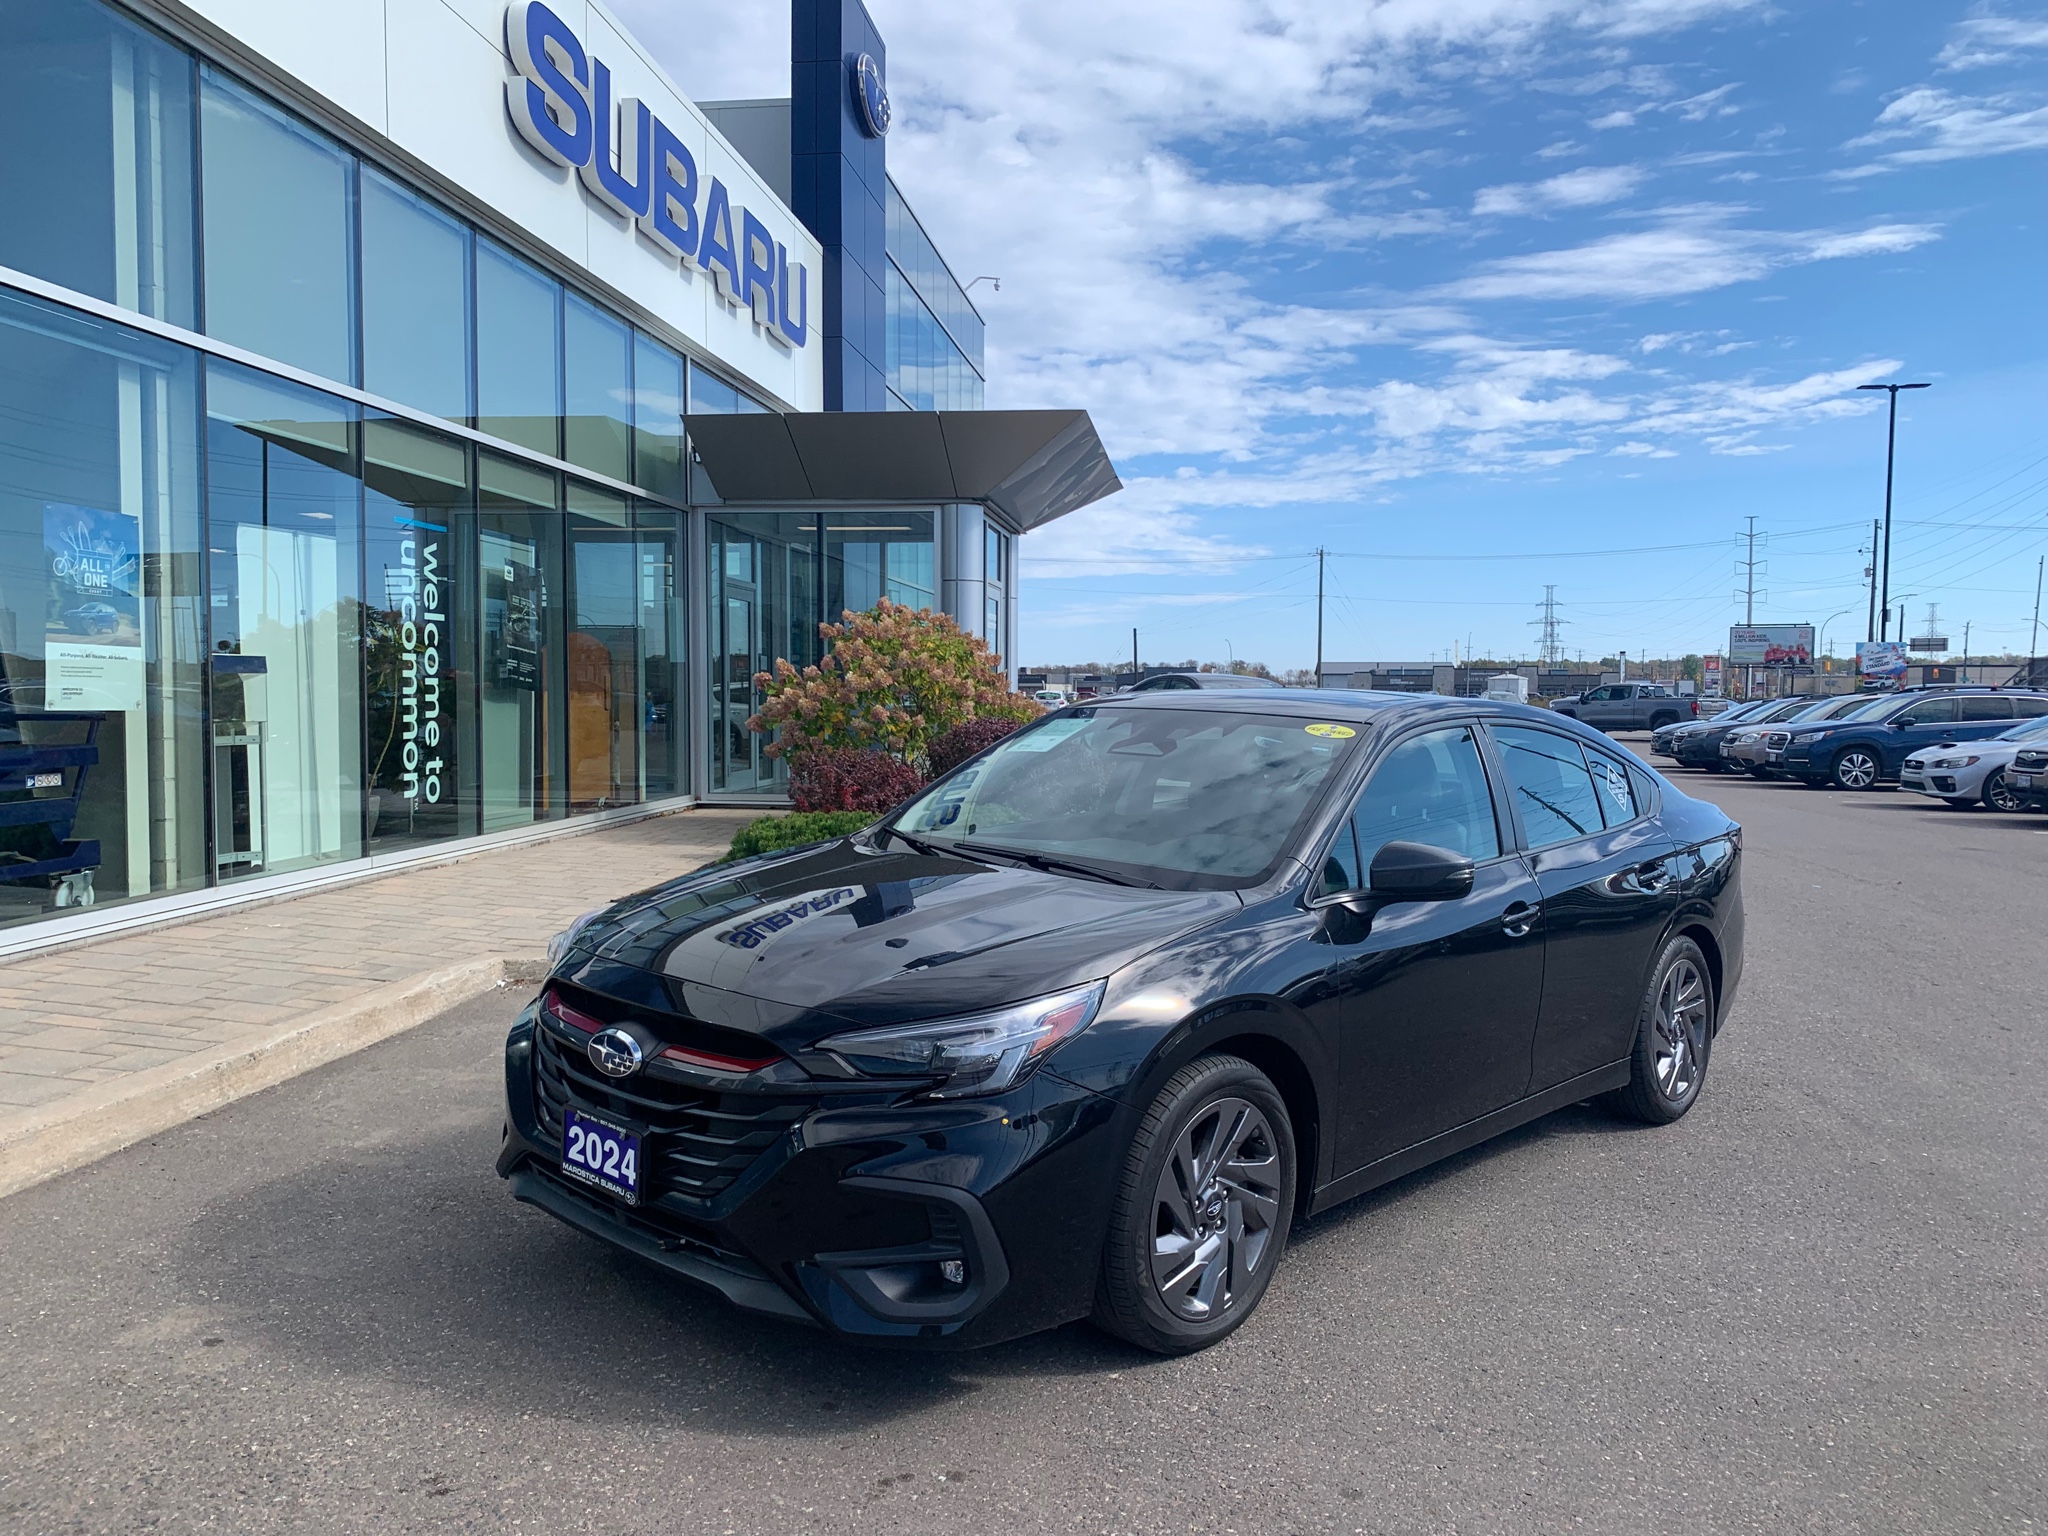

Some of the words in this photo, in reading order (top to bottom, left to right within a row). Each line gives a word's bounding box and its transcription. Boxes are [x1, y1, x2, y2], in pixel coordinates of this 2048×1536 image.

[508, 0, 806, 348] SUBARU
[80, 557, 104, 573] ALL
[84, 572, 108, 588] ONE
[423, 542, 446, 748] welcome
[1865, 660, 1891, 671] STANDARD
[400, 539, 419, 799] uncommon
[425, 756, 444, 804] to
[1617, 793, 1625, 804] S
[568, 1125, 636, 1186] 2024
[562, 1162, 600, 1184] MAROSTICA
[600, 1179, 625, 1196] SUBARU
